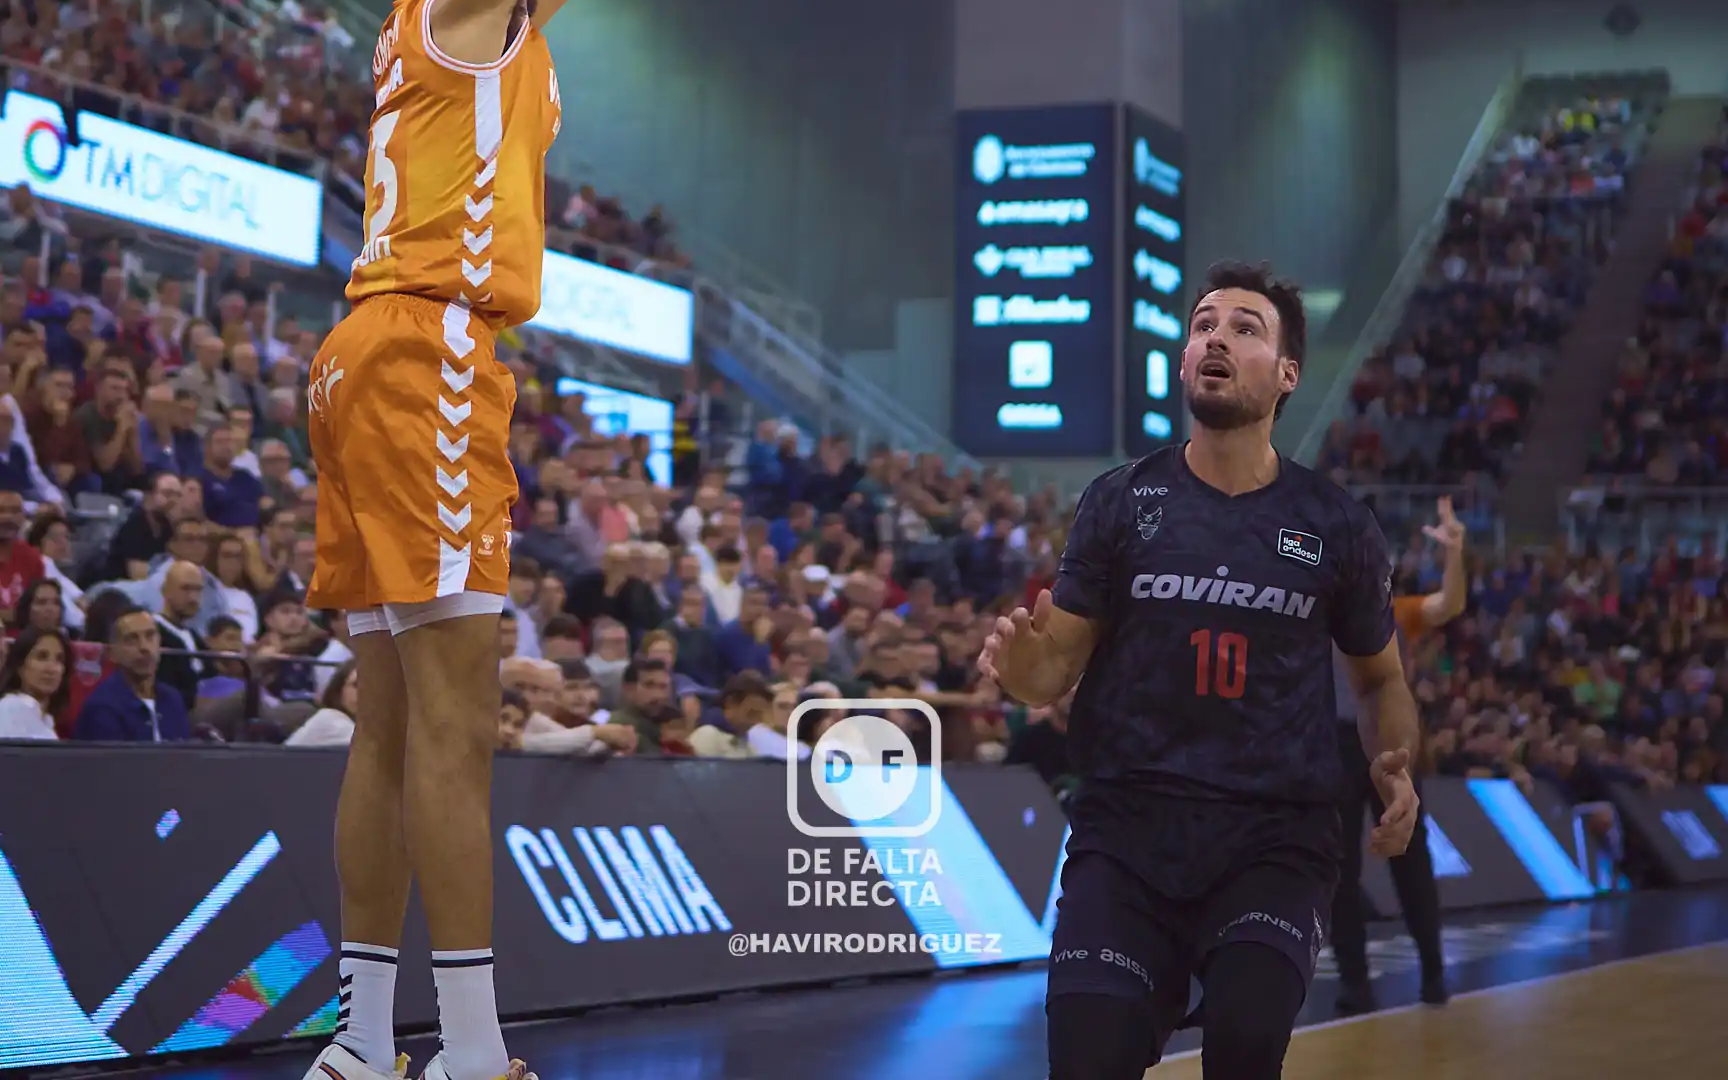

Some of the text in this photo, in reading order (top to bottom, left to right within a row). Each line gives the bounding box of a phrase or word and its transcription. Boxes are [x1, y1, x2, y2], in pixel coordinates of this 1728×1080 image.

[1132, 485, 1169, 497] vive
[1282, 544, 1318, 561] endesa
[1190, 628, 1248, 699] 10
[505, 823, 733, 944] CLIMA
[1054, 949, 1089, 964] vive
